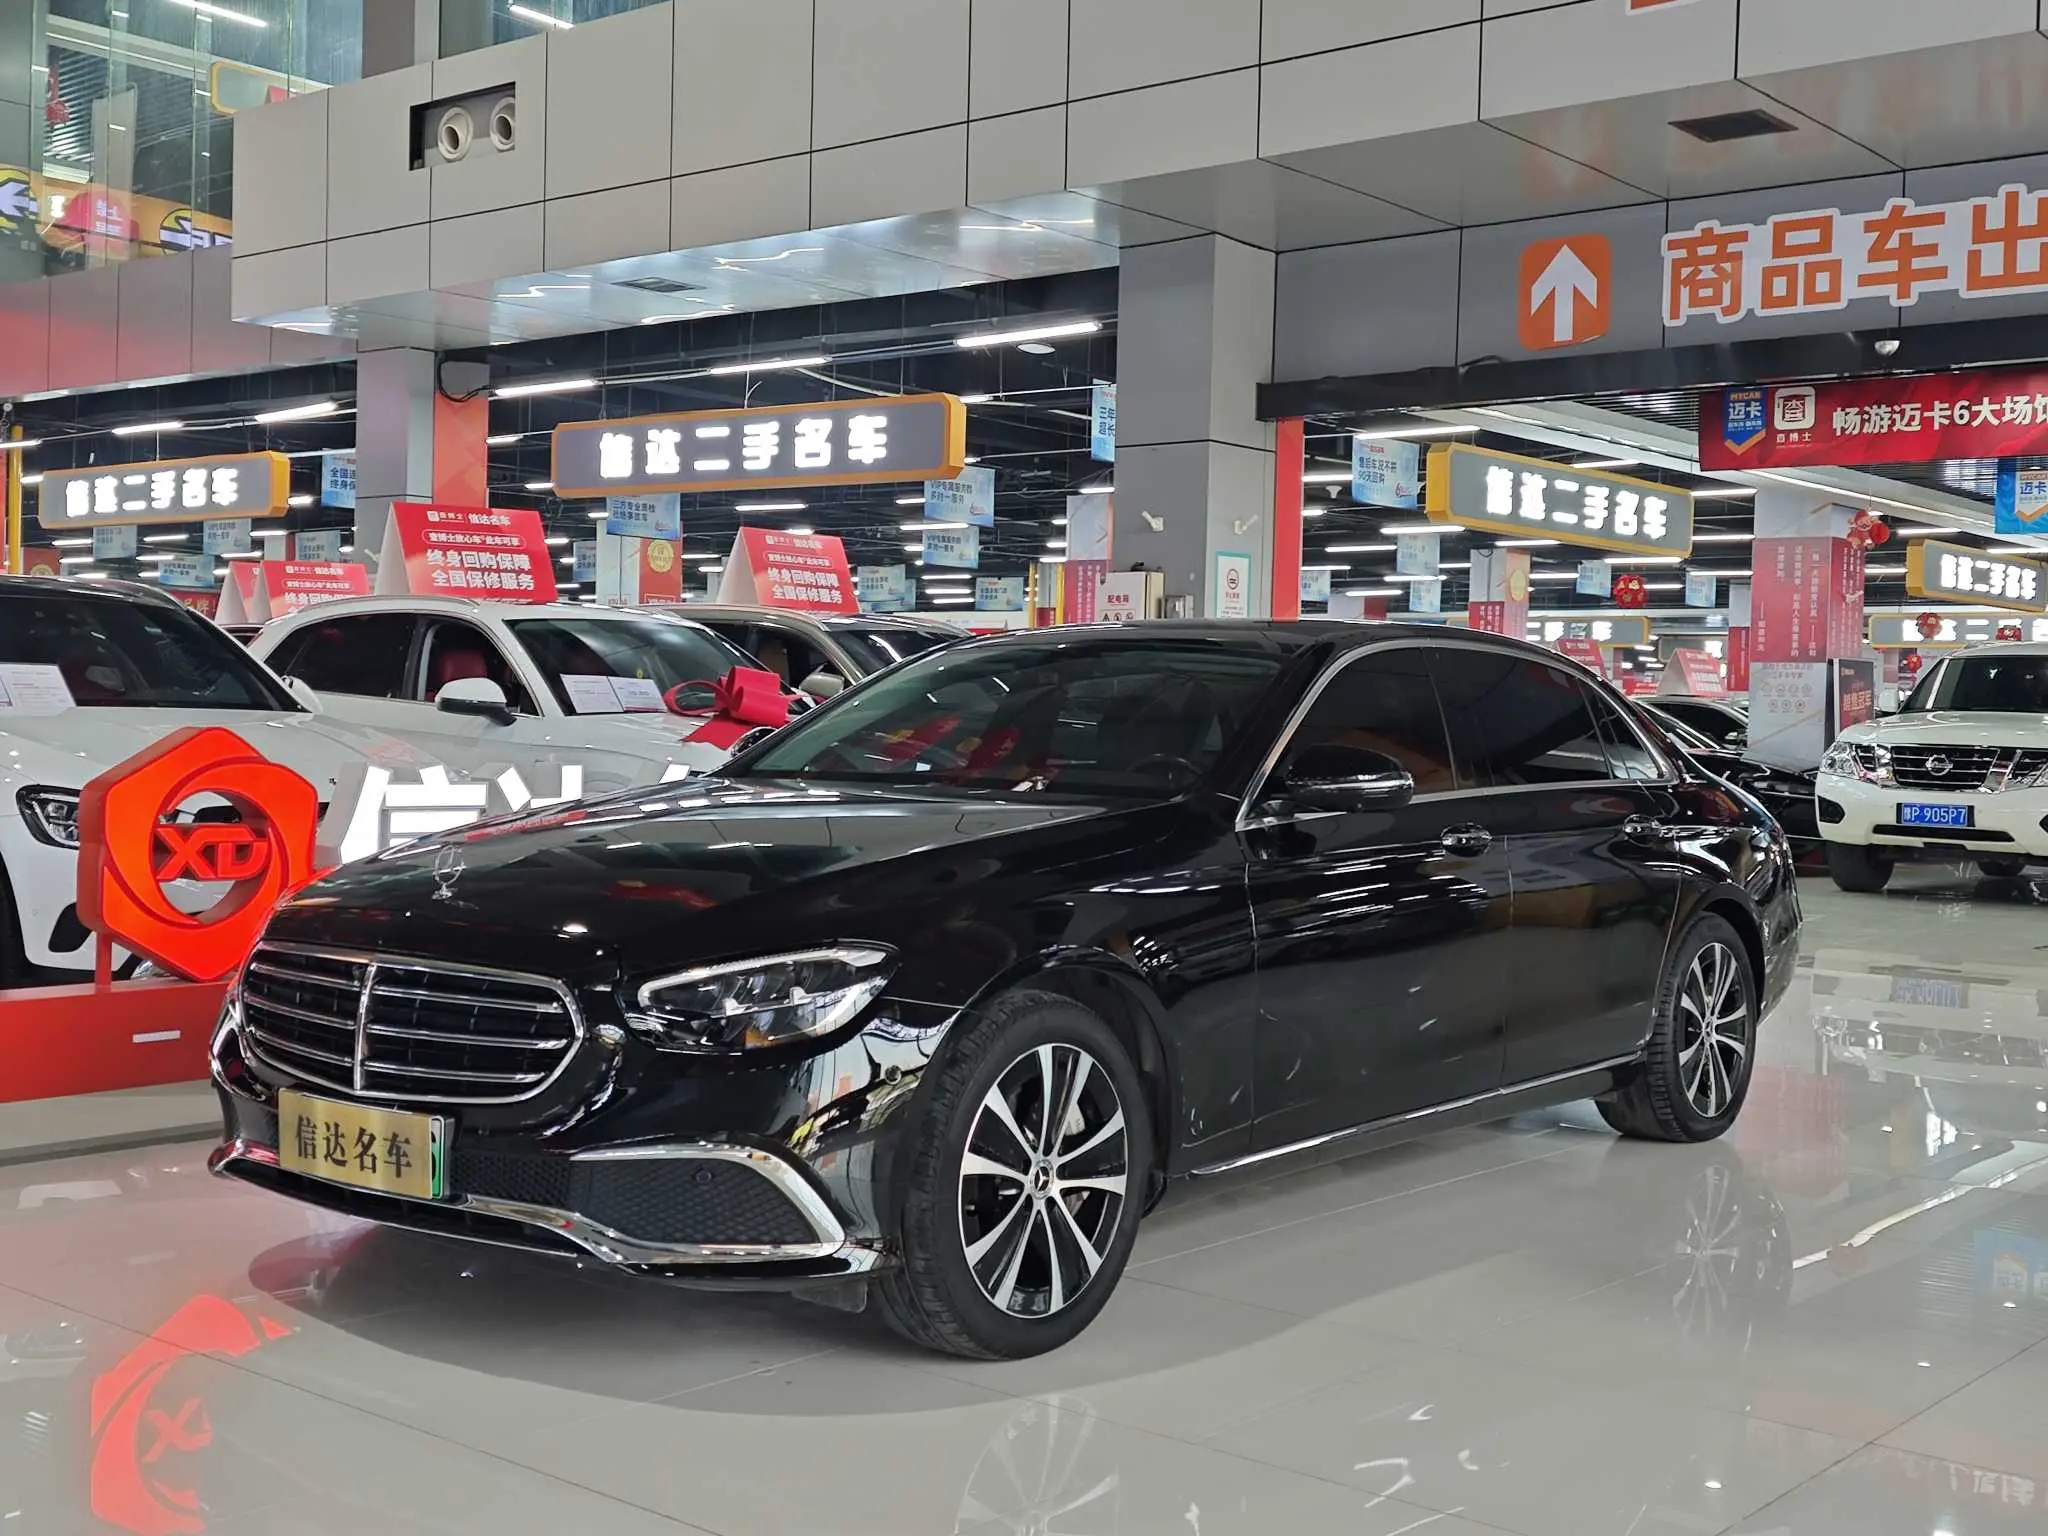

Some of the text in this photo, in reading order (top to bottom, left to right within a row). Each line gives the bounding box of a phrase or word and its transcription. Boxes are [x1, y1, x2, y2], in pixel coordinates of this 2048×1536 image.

[1665, 187, 2048, 324] 商品车出
[1728, 401, 1762, 420] 迈卡
[600, 414, 888, 478] 信达二手名车
[2019, 481, 2048, 495] 迈卡
[426, 548, 532, 571] 终身回购保障
[431, 569, 535, 591] 全国保修服务
[155, 822, 270, 882] XD
[296, 1114, 412, 1179] 信达名车
